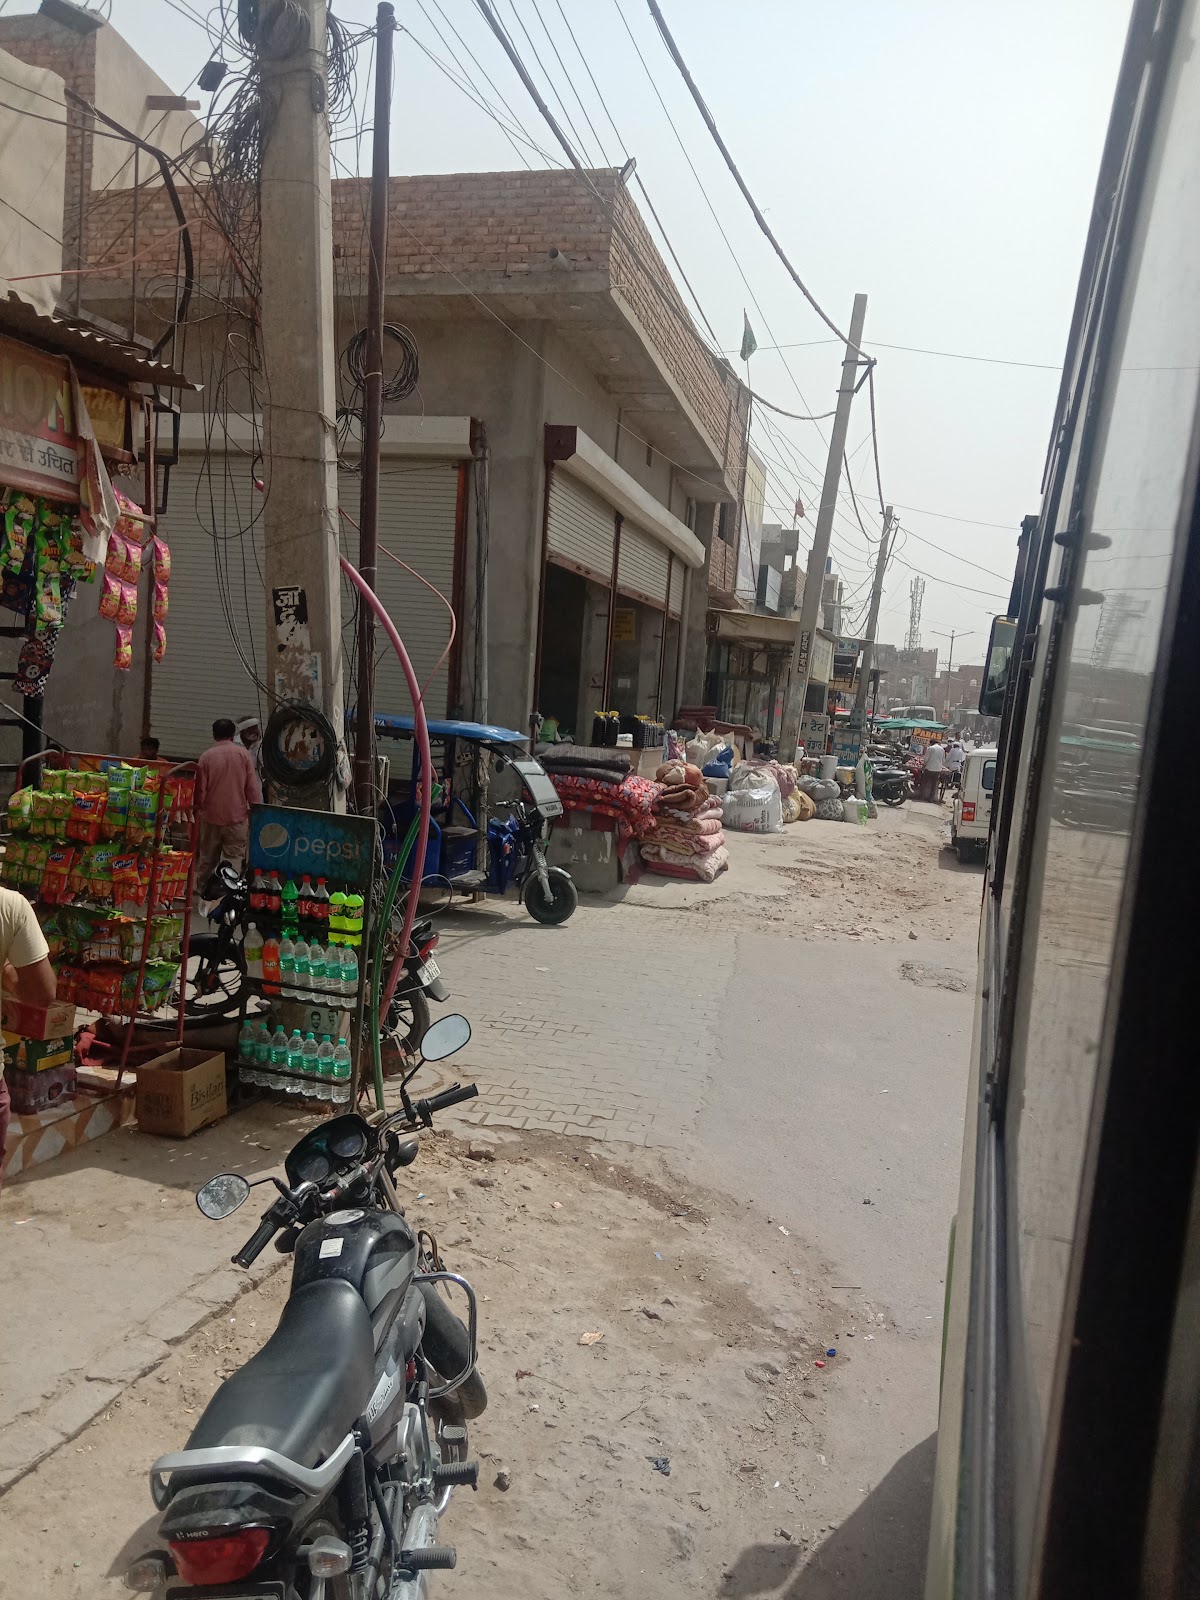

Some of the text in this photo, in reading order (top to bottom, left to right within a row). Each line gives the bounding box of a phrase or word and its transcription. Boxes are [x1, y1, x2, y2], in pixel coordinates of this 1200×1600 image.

[37, 446, 76, 476] उचित
[294, 836, 361, 862] pepsi
[186, 1530, 209, 1539] Hero
